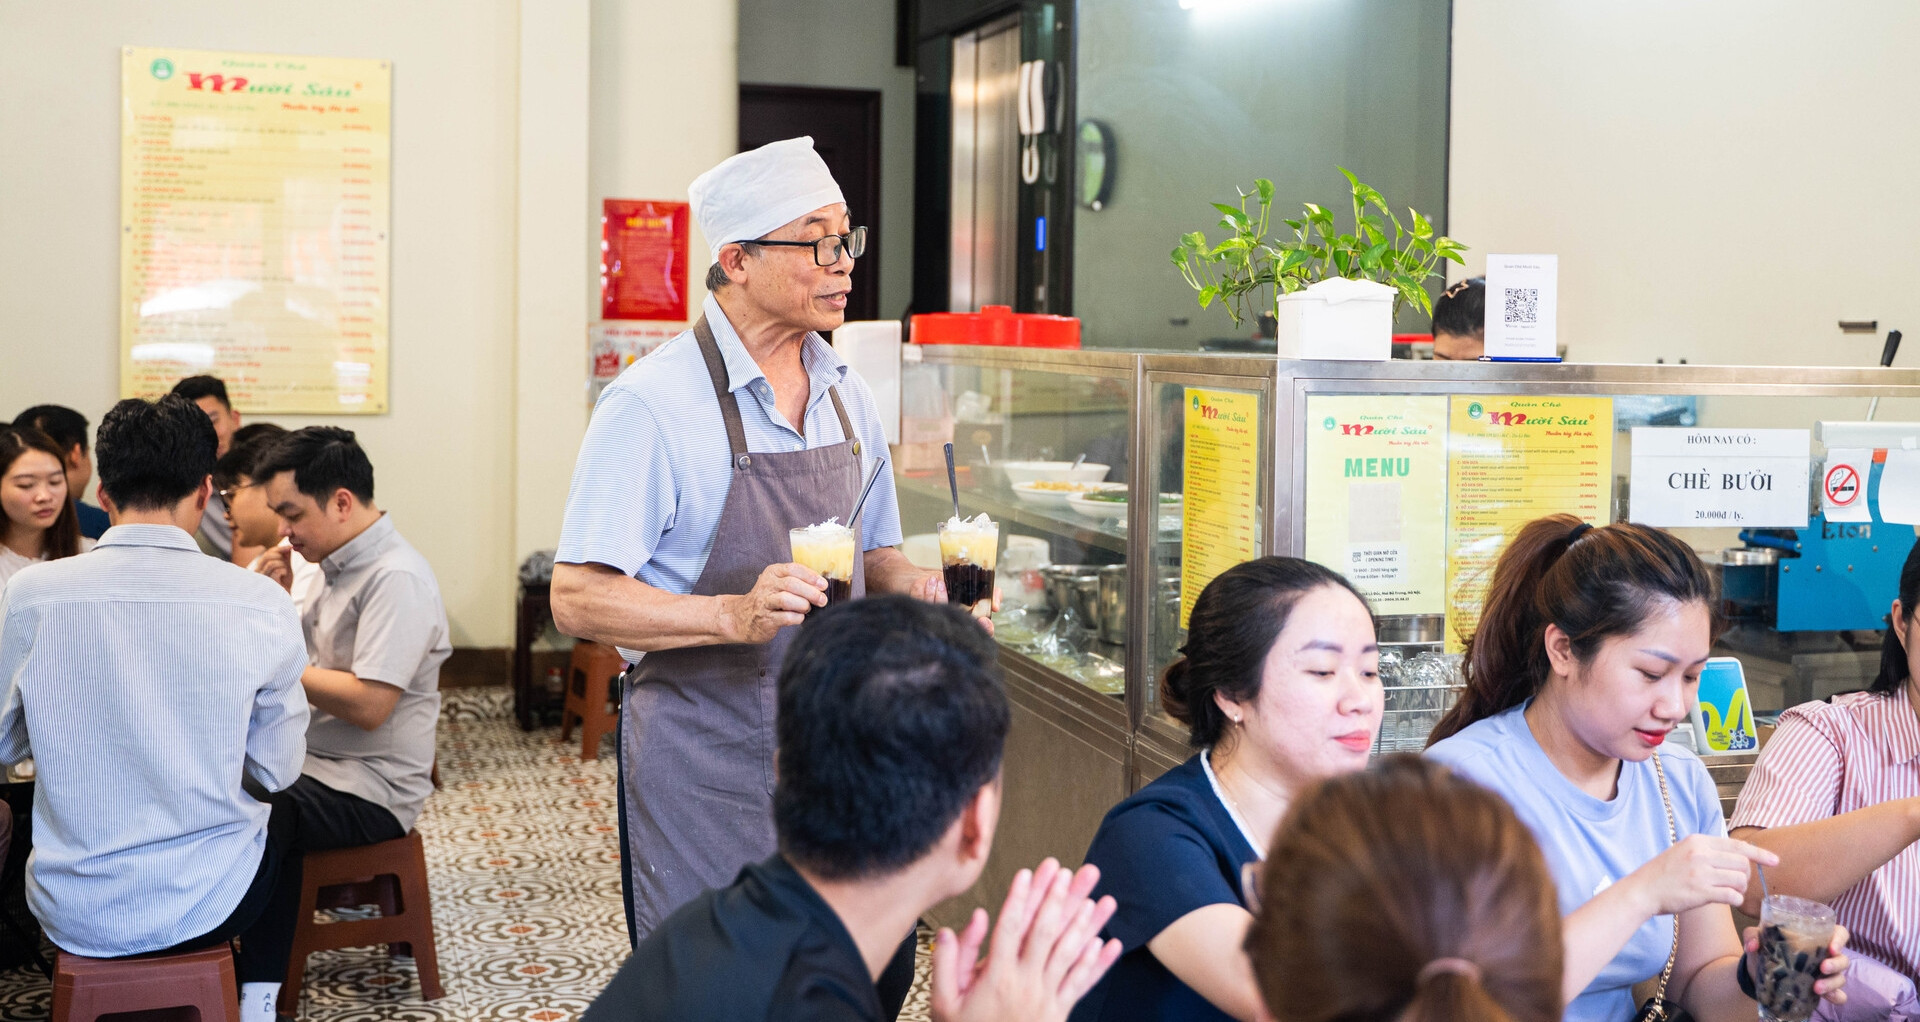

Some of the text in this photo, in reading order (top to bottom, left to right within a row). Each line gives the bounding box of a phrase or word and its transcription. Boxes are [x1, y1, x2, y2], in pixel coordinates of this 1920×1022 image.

[1487, 411, 1589, 427] Mười Sáu
[1340, 424, 1428, 437] Mười Sáu
[1687, 433, 1711, 445] HÔM
[1713, 435, 1734, 444] NAY
[1736, 433, 1751, 445] CÓ
[1344, 458, 1410, 478] MENU
[1668, 467, 1773, 491] CHÈ BƯỞI
[1821, 521, 1872, 540] Eton
